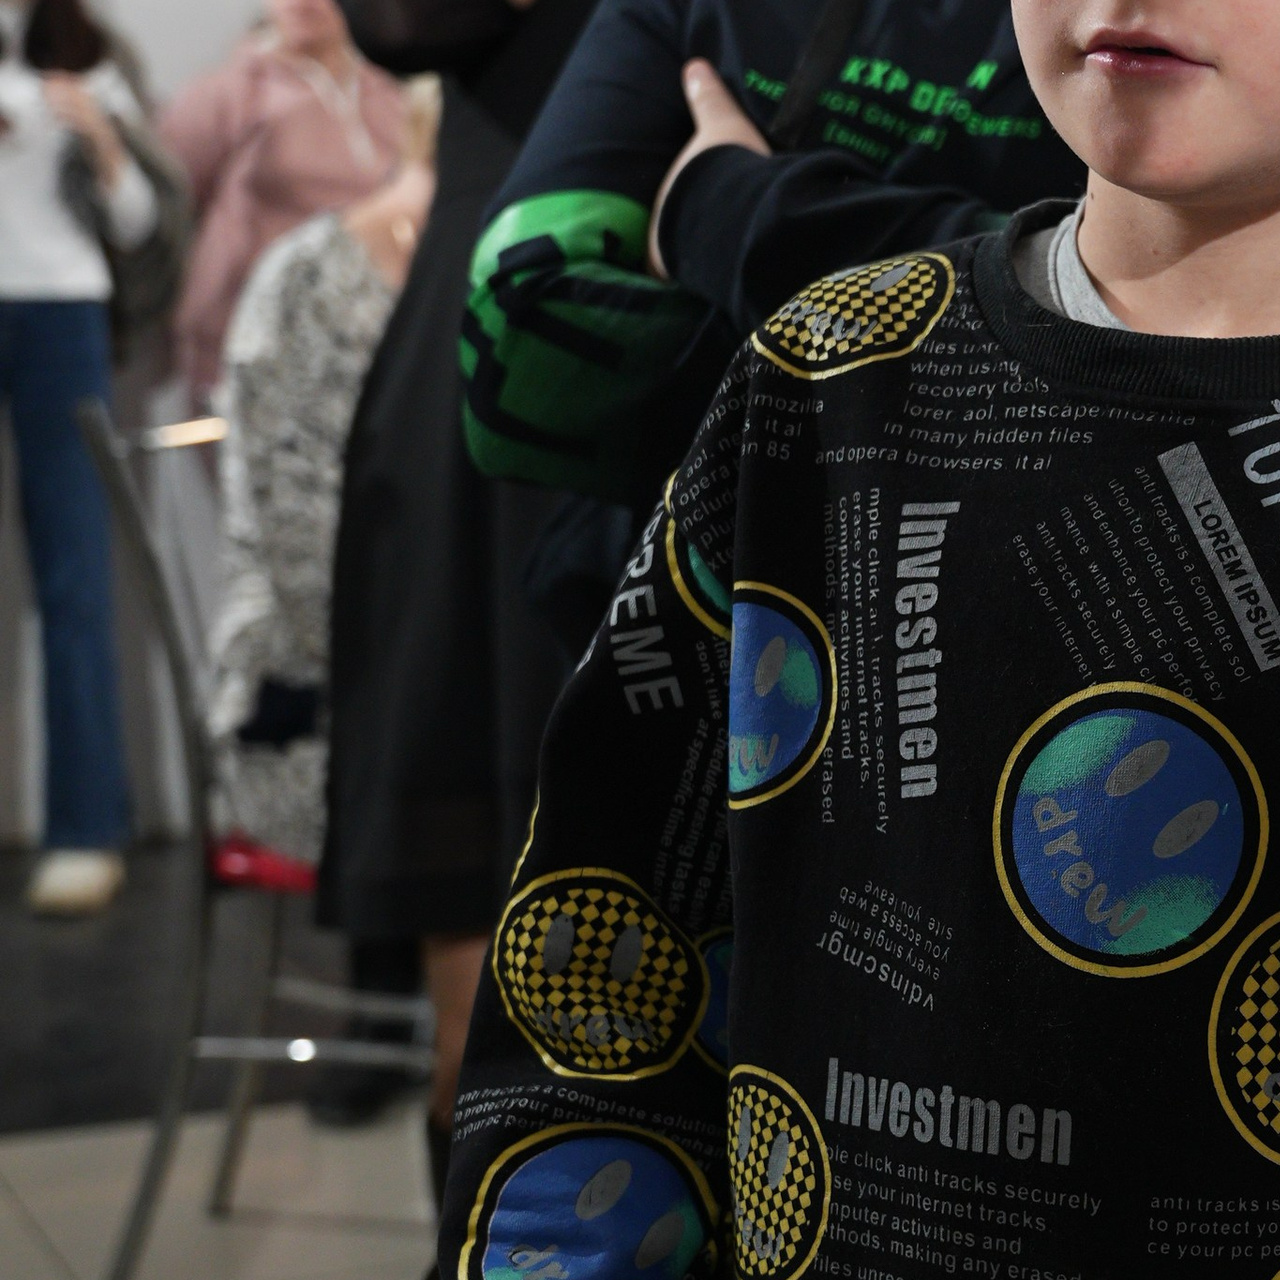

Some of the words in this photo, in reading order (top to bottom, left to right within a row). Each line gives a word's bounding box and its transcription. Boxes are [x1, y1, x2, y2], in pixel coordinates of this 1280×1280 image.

[908, 380, 996, 400] recovery
[911, 359, 961, 376] when
[753, 392, 824, 414] mozilla
[767, 441, 791, 461] 85
[909, 427, 966, 446] many
[974, 426, 1042, 445] hidden
[1048, 427, 1094, 446] files
[852, 490, 862, 554] erase
[866, 487, 881, 542] mple
[1193, 499, 1248, 582] LOREM
[838, 495, 851, 603] computer
[867, 547, 880, 599] click
[1099, 521, 1136, 586] enhance
[1128, 587, 1156, 625] your
[1151, 494, 1181, 544] tracks
[1190, 575, 1234, 652] complete
[851, 560, 863, 609] your
[1013, 533, 1038, 575] erase
[1031, 577, 1058, 613] your
[1055, 615, 1092, 681] internet
[1050, 549, 1082, 599] tracks
[1077, 601, 1117, 671] securely
[1060, 506, 1090, 555] mance
[1087, 560, 1111, 595] with
[1112, 609, 1143, 664] simple
[1135, 536, 1174, 594] protect
[1164, 595, 1193, 635] your
[1186, 636, 1226, 702] privacy
[840, 607, 851, 712] activities
[855, 615, 868, 708] internet
[895, 500, 961, 800] Investmen
[871, 656, 884, 729] tracks
[841, 717, 855, 761] and
[874, 733, 888, 835] securely
[1031, 795, 1148, 938] drew
[864, 880, 898, 912] leave
[863, 926, 904, 959] single
[882, 910, 922, 946] access
[816, 930, 934, 1012] vdinscmgr
[556, 1086, 647, 1122] complete
[824, 1057, 1073, 1167] Investmen
[854, 1150, 893, 1176] click
[897, 1160, 929, 1183] anti
[934, 1163, 998, 1197] tracks
[1003, 1183, 1103, 1217] securely
[858, 1179, 896, 1203] your
[900, 1184, 973, 1219] internet
[1150, 1195, 1191, 1211] anti
[1197, 1196, 1260, 1213] tracks
[891, 1213, 976, 1249] activities
[982, 1234, 1022, 1255] and
[1176, 1218, 1251, 1241] protect
[1178, 1241, 1226, 1261] your
[1231, 1241, 1255, 1259] pc
[813, 1253, 852, 1277] files
[890, 1239, 957, 1273] making
[962, 1256, 1000, 1280] any
